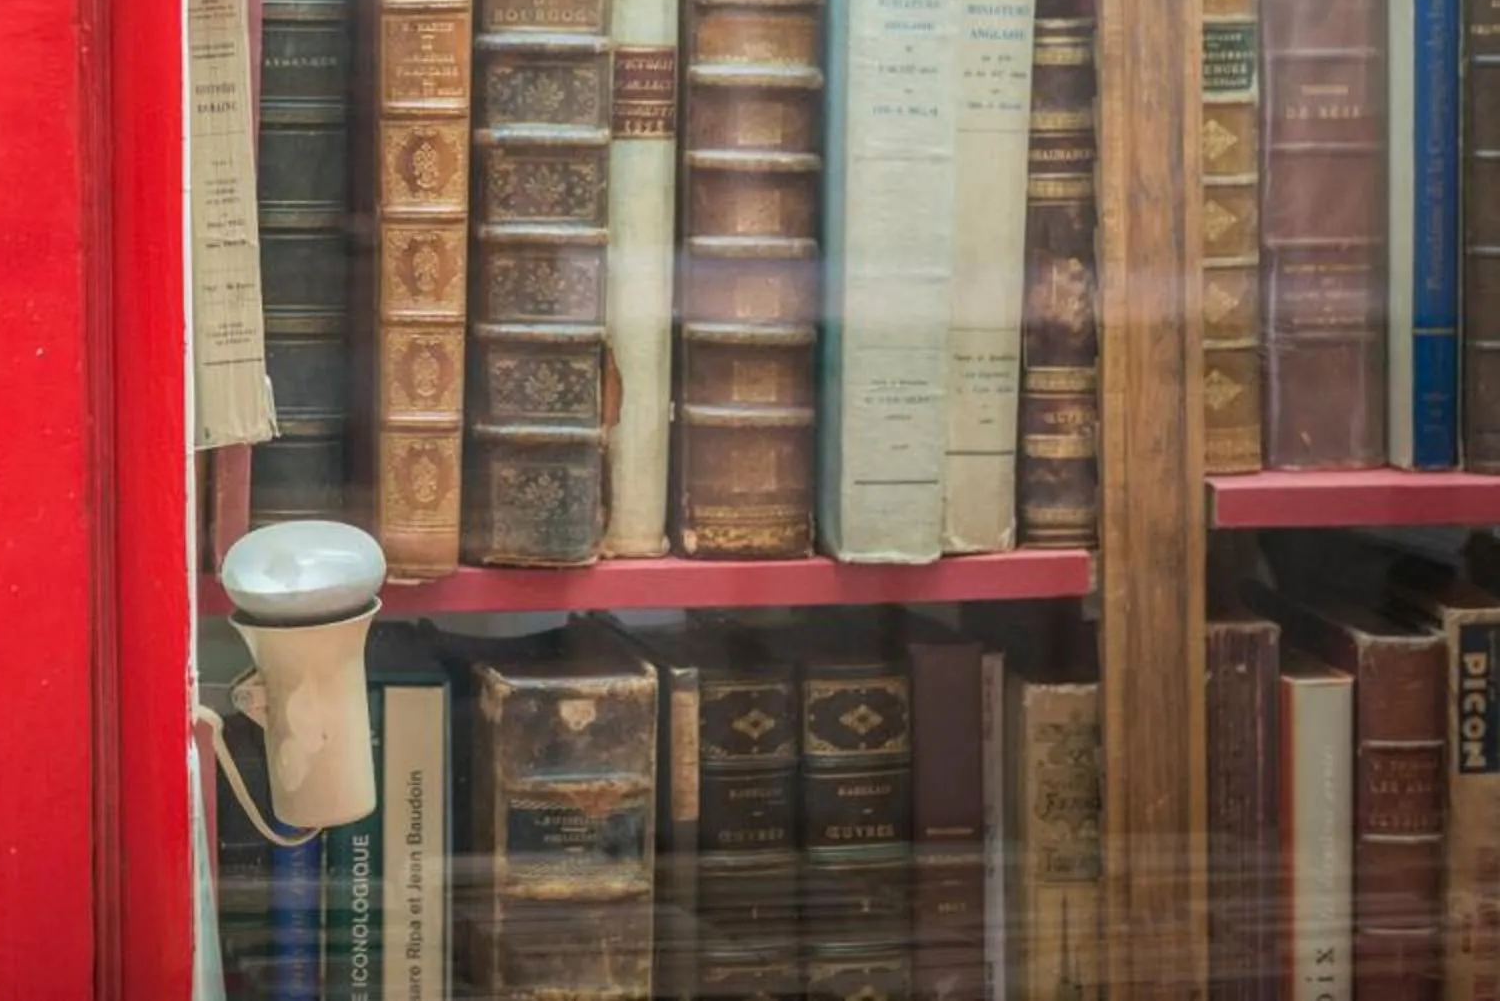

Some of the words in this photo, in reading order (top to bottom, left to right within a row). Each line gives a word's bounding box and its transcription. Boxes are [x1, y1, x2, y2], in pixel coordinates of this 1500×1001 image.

[1461, 651, 1488, 768] PICON
[405, 769, 423, 846] Baudoin
[405, 851, 423, 891] Jean
[352, 834, 370, 988] ICONOLOGIQUE
[408, 894, 422, 915] et
[405, 919, 424, 961] Ripa
